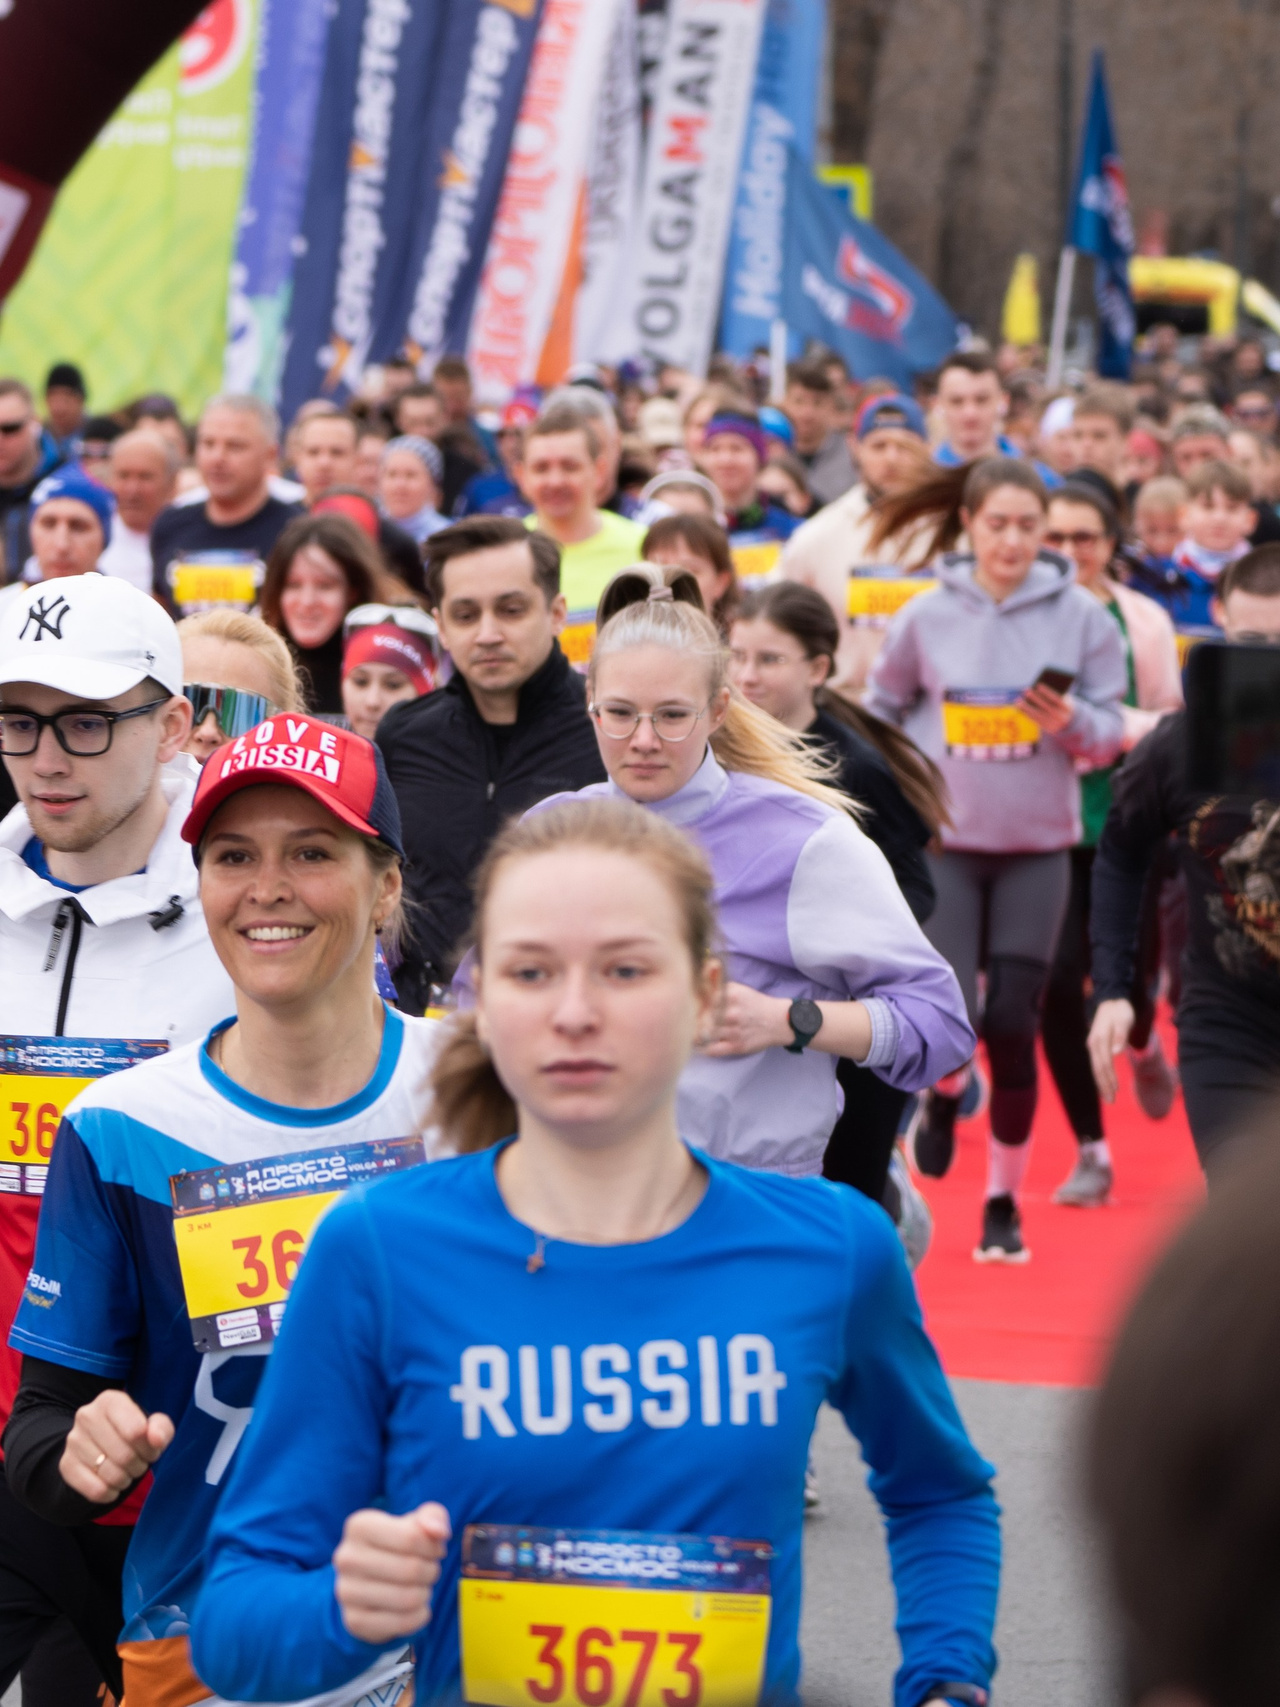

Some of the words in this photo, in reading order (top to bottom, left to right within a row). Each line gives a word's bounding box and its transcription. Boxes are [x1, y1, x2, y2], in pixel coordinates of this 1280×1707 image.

[232, 718, 338, 755] LOVE
[221, 743, 341, 784] RUSSIA
[246, 1167, 348, 1195] КОСМОС
[262, 1155, 346, 1179] ПРОСТО
[187, 1223, 195, 1233] 3
[449, 1333, 788, 1440] RUSSIA
[524, 1623, 704, 1707] 3673
